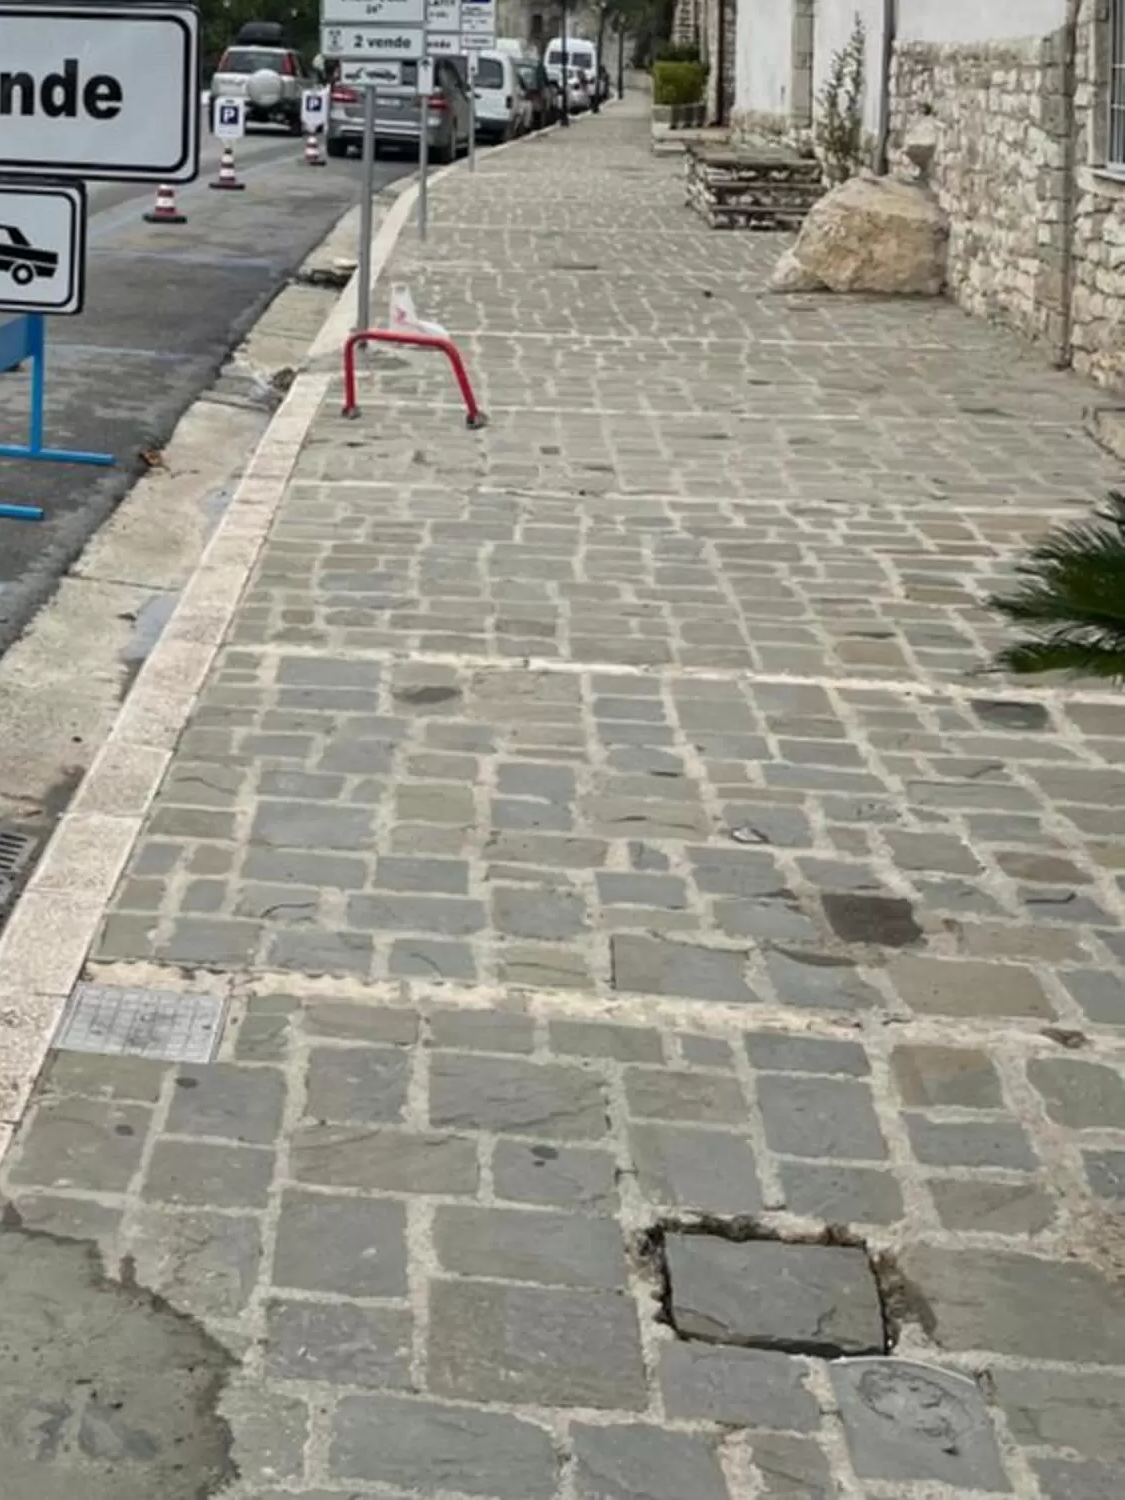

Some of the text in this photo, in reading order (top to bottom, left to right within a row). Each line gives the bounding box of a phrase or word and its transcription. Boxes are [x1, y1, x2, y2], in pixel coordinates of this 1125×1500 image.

[354, 34, 412, 49] 2 vende
[307, 98, 319, 111] P
[222, 107, 236, 123] P
